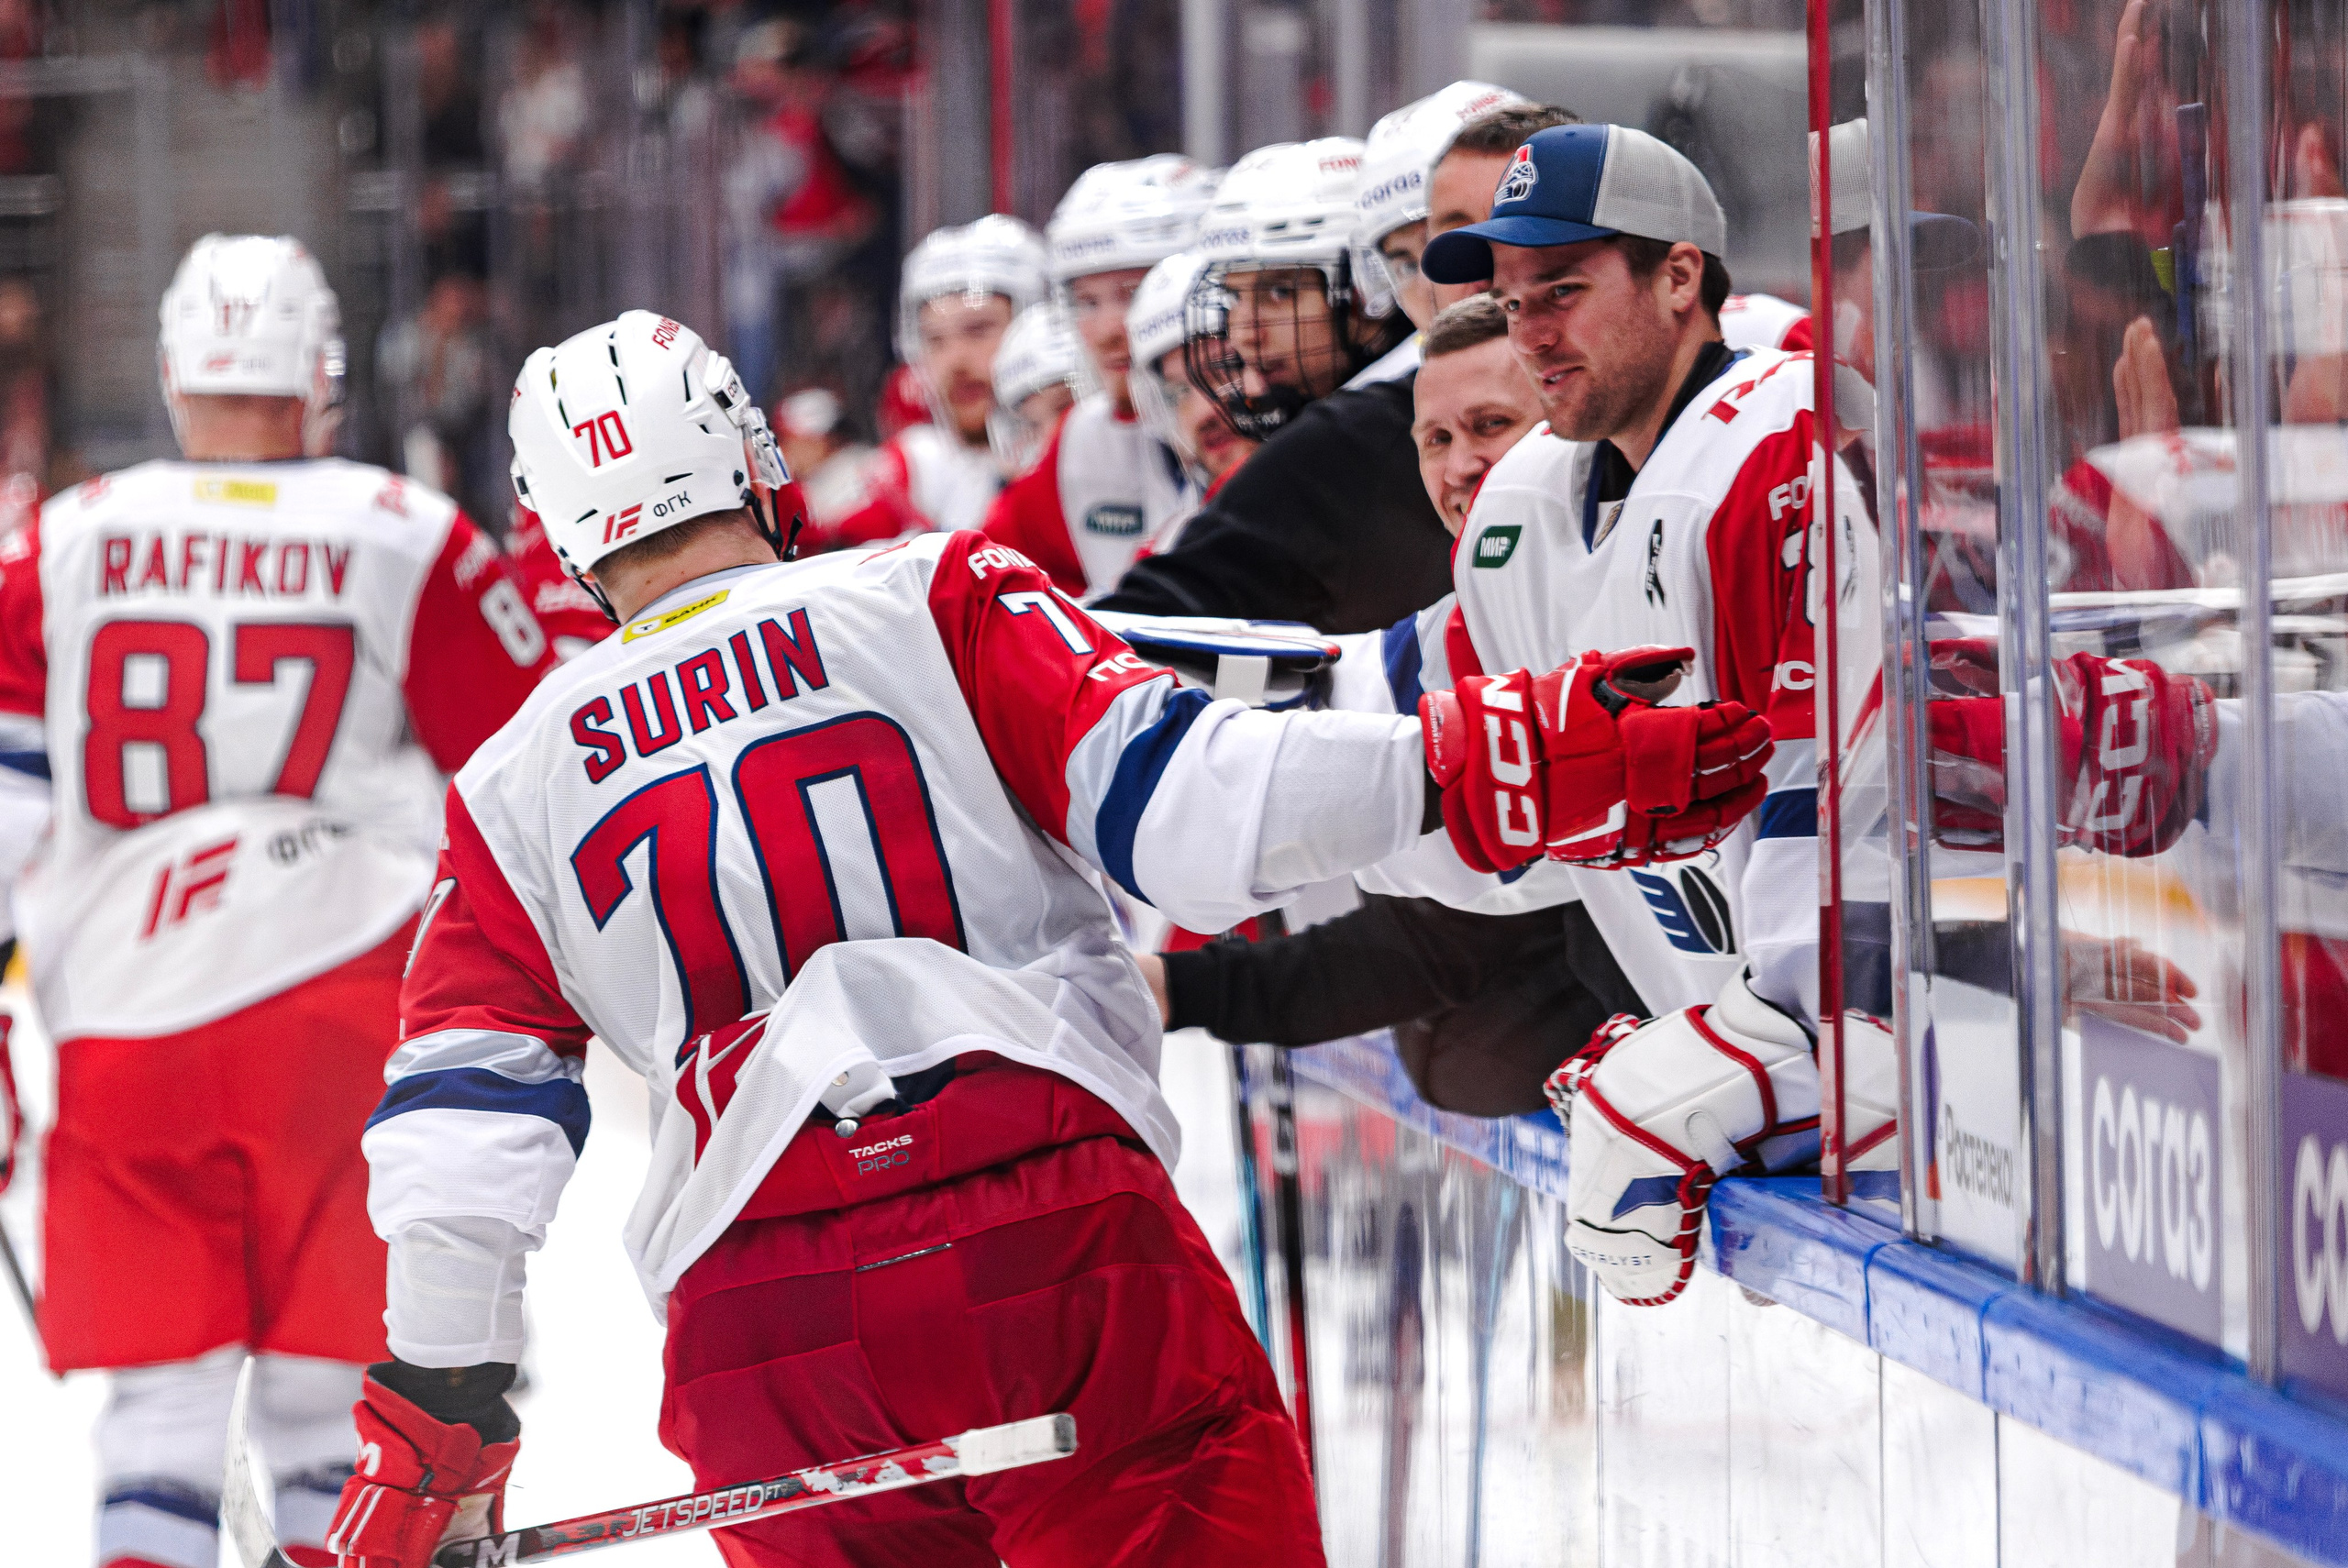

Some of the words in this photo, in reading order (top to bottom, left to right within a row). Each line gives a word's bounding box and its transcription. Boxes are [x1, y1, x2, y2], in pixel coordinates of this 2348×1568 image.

[572, 409, 633, 469] 70
[101, 532, 352, 598] RAFIKOV
[83, 618, 357, 831] 87
[570, 607, 829, 784] SURIN
[570, 711, 969, 1070] 70
[848, 1134, 914, 1159] TACKS
[858, 1150, 911, 1176] PRO
[621, 1485, 765, 1539] JETSPEED
